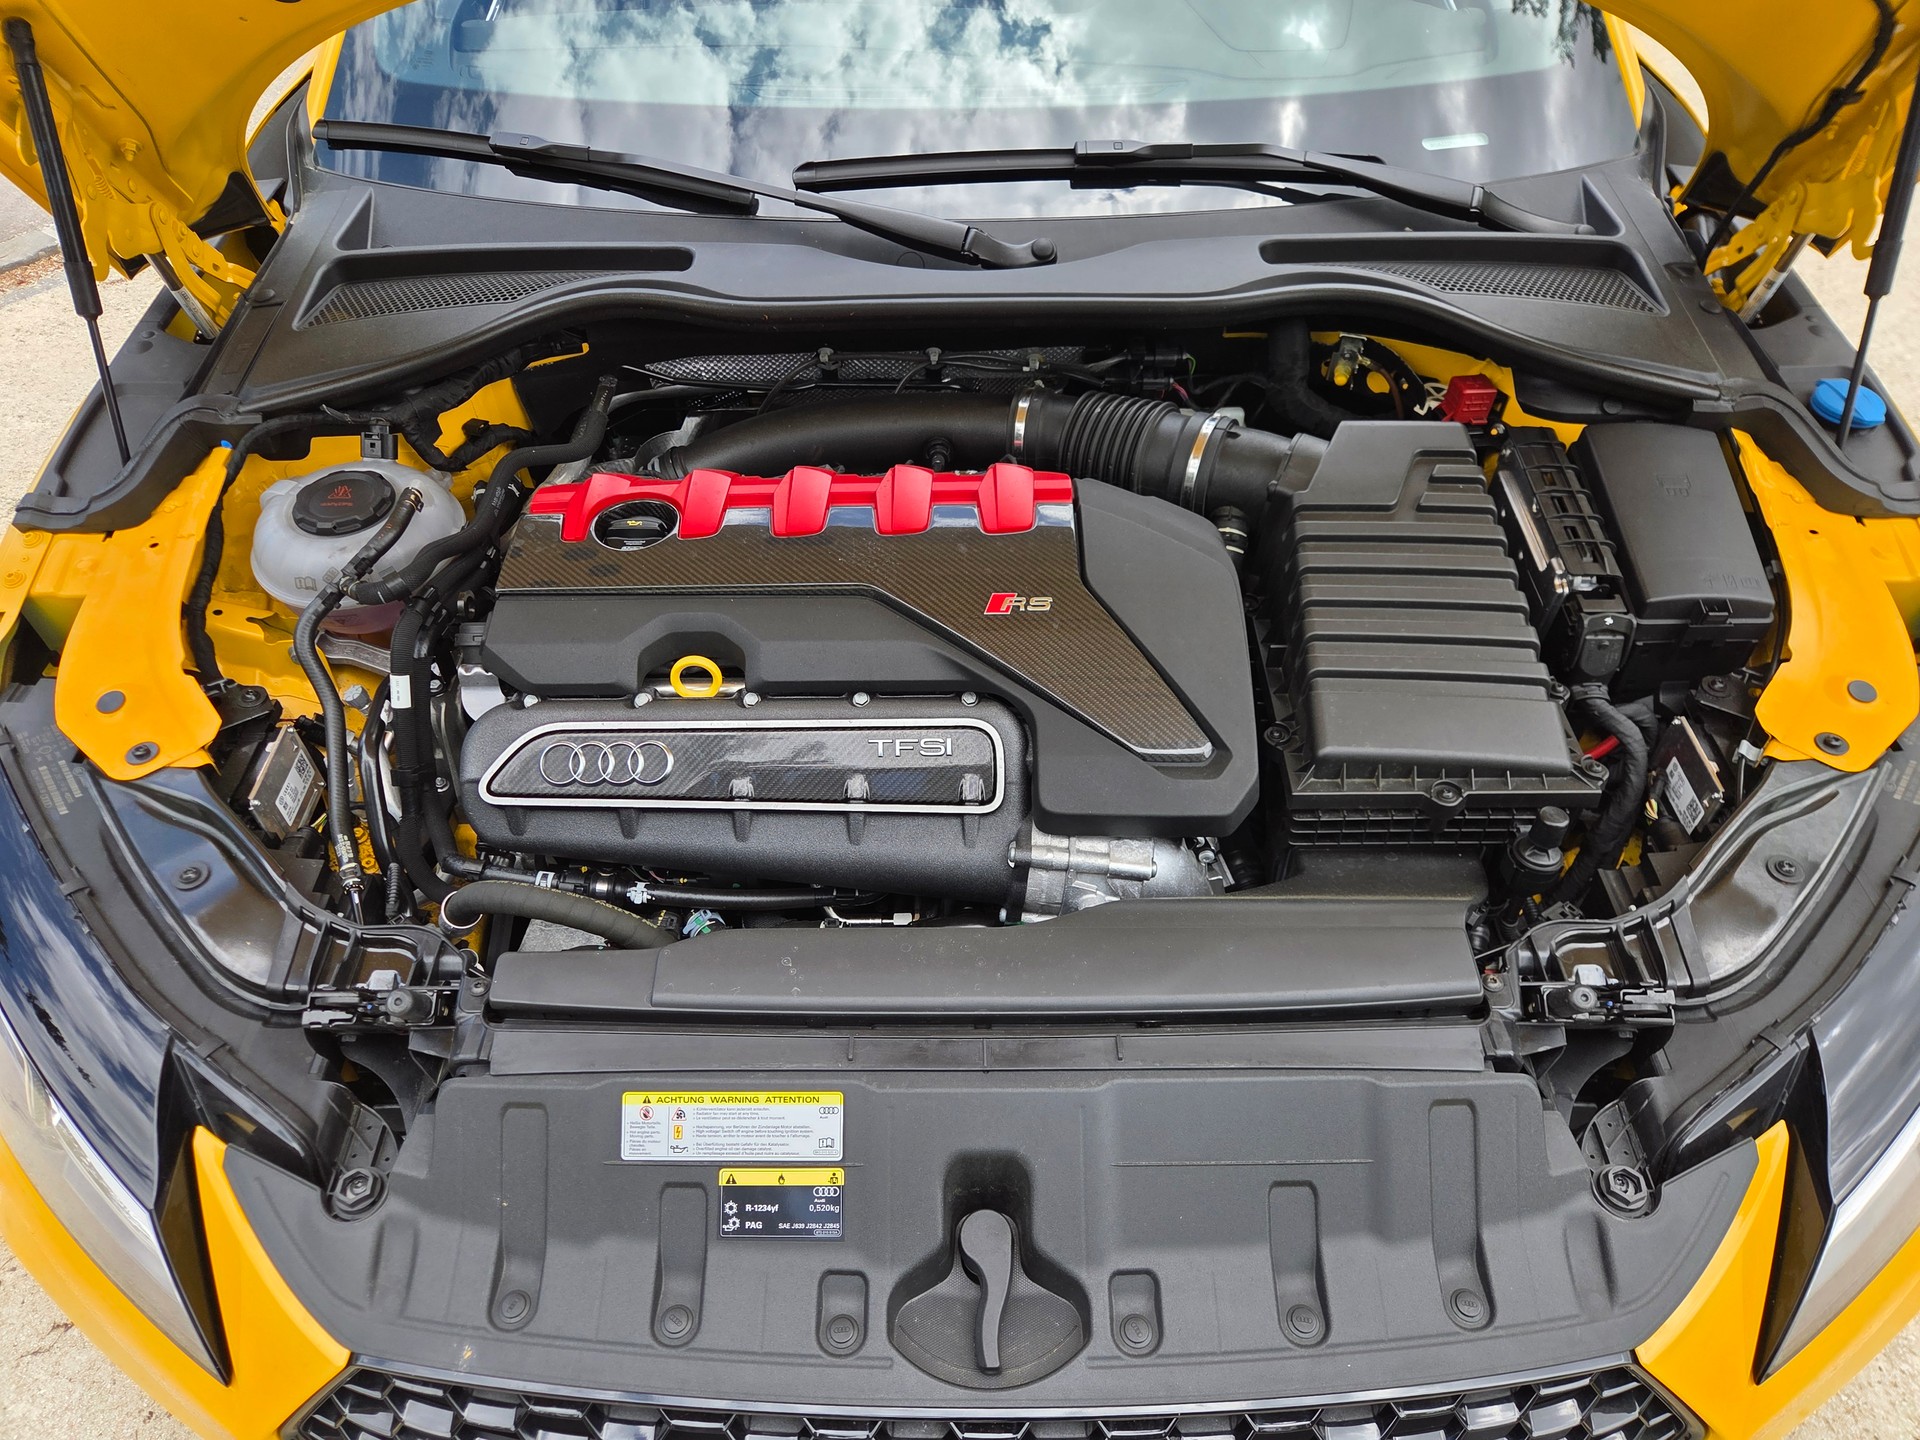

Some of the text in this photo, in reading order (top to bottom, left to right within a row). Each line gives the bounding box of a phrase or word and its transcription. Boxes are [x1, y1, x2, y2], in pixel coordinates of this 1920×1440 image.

[1000, 597, 1053, 611] RS
[868, 737, 953, 757] TFSI
[656, 1096, 820, 1104] ACHTUNG WARNING ATTENTION
[745, 1204, 779, 1213] R-1234yf
[809, 1204, 840, 1213] 0,520kg
[745, 1221, 763, 1229] PAG
